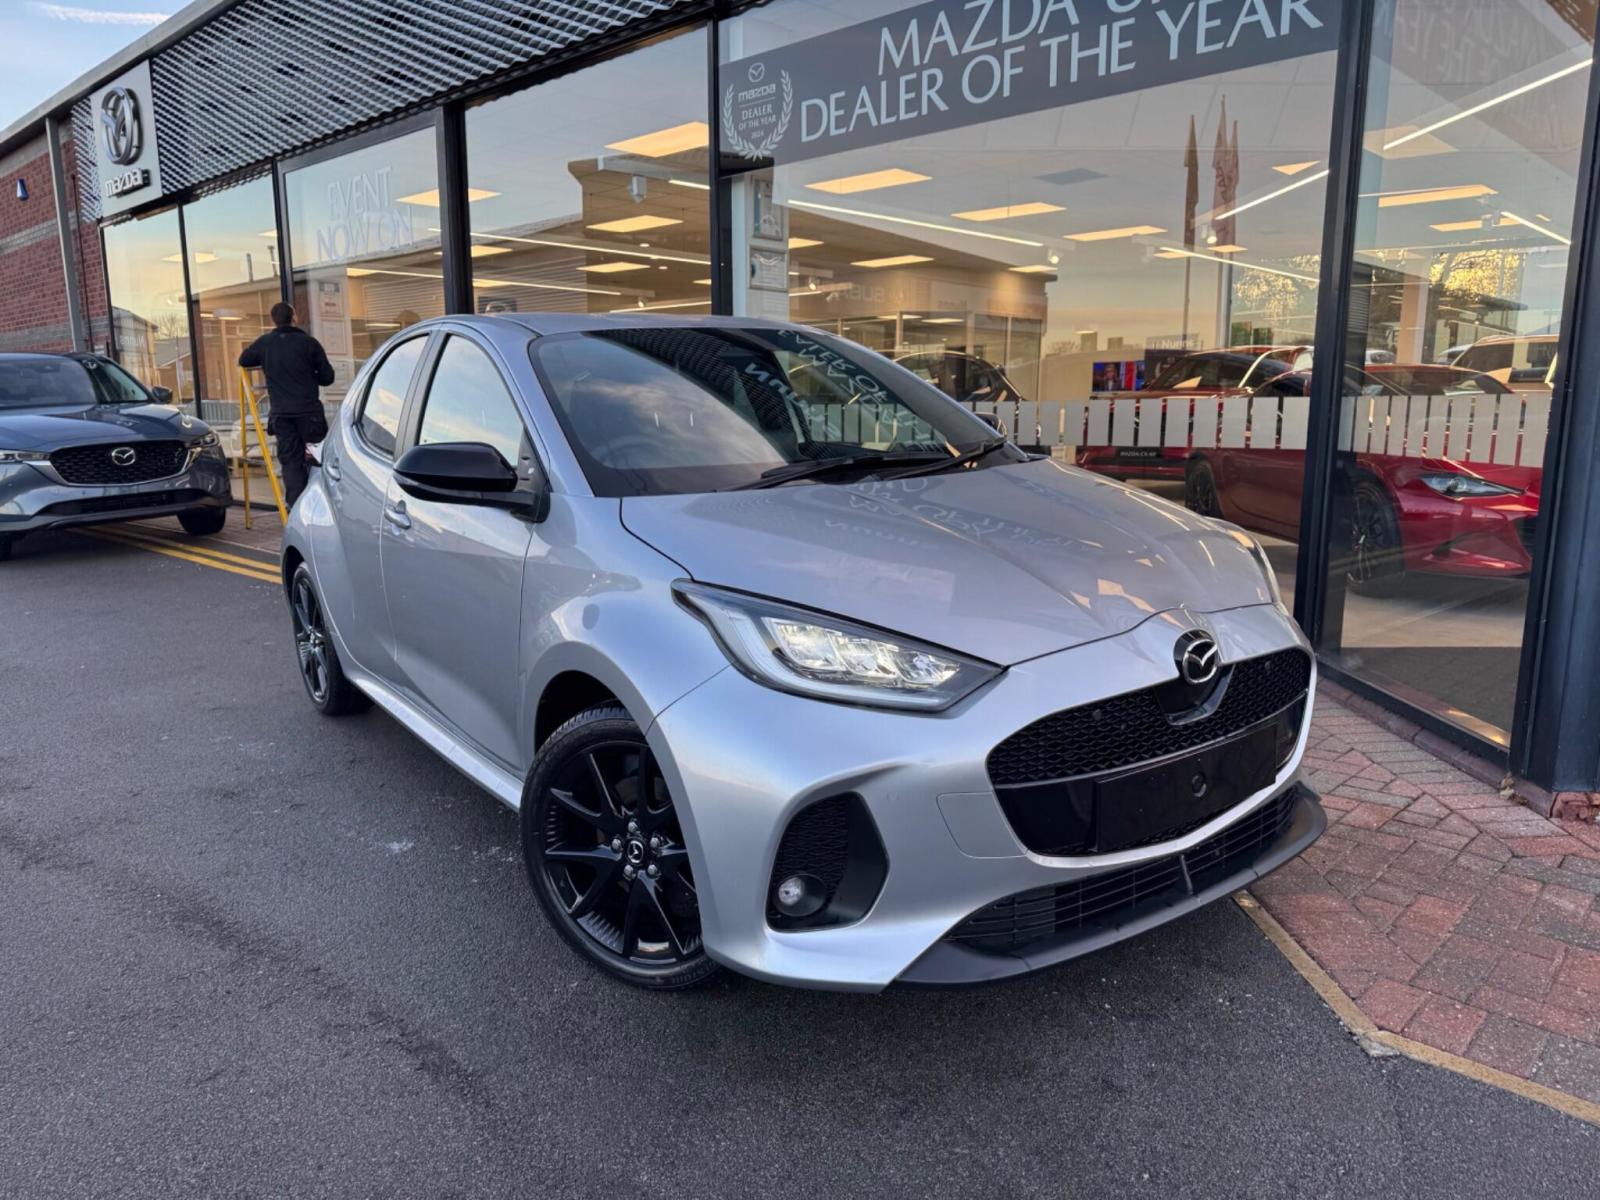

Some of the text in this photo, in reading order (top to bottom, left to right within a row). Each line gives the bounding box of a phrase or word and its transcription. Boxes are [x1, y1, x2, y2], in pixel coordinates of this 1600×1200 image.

[878, 0, 1080, 76] MAZDA
[801, 67, 949, 142] DEALER
[961, 45, 1025, 104] OF
[1039, 17, 1136, 87] THE
[1155, 0, 1323, 60] YEAR
[738, 114, 777, 131] OF THE YEAR
[742, 103, 773, 120] DEALER
[327, 166, 391, 219] EVENT
[316, 204, 414, 261] NOW ON
